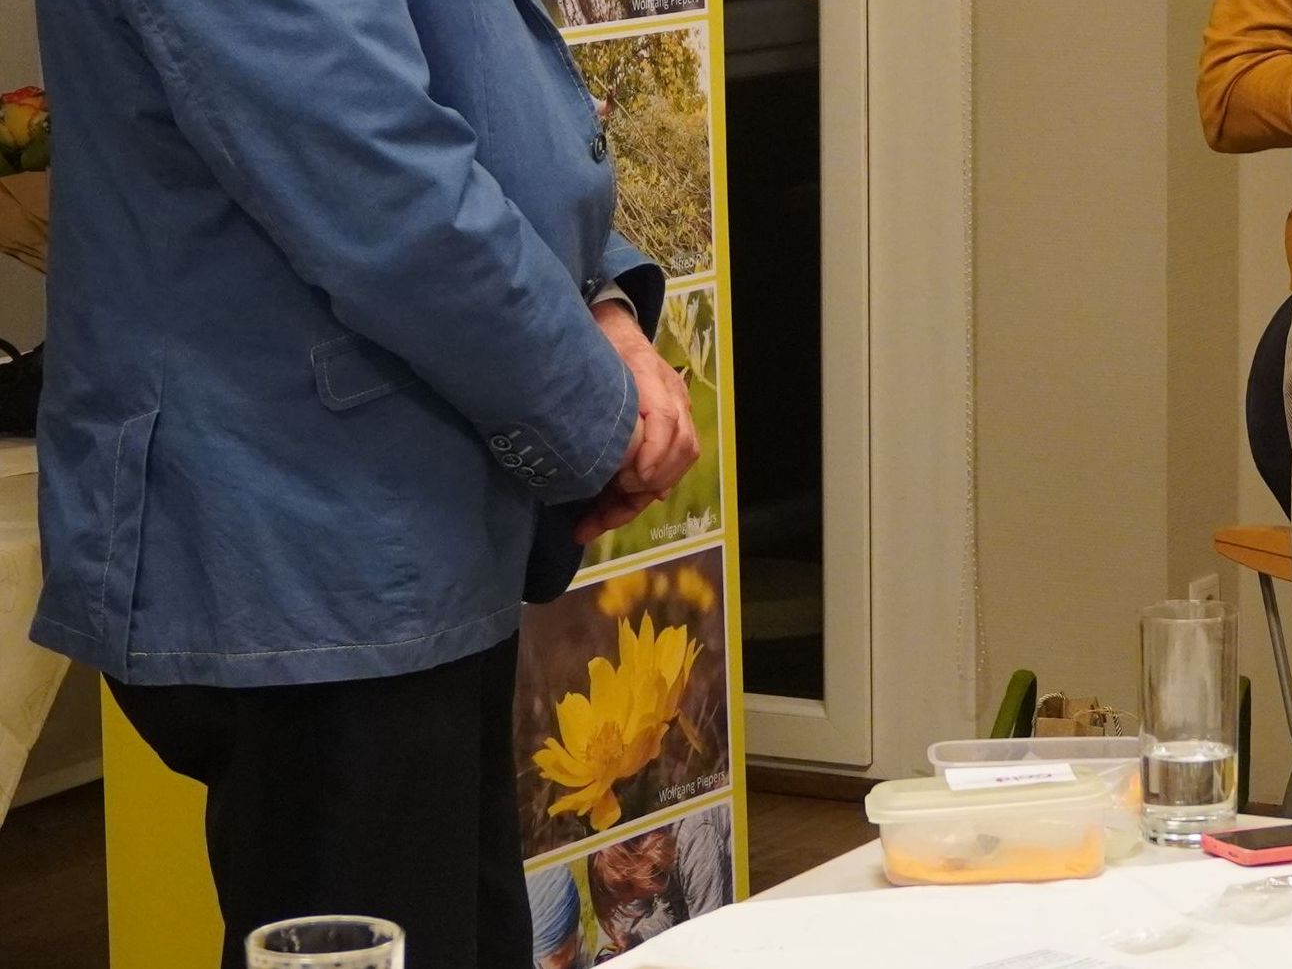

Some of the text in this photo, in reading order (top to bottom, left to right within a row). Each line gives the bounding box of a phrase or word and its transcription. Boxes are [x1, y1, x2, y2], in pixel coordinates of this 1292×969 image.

[649, 521, 688, 541] Wolfgang
[658, 771, 725, 802] Wolfgang Piepers
